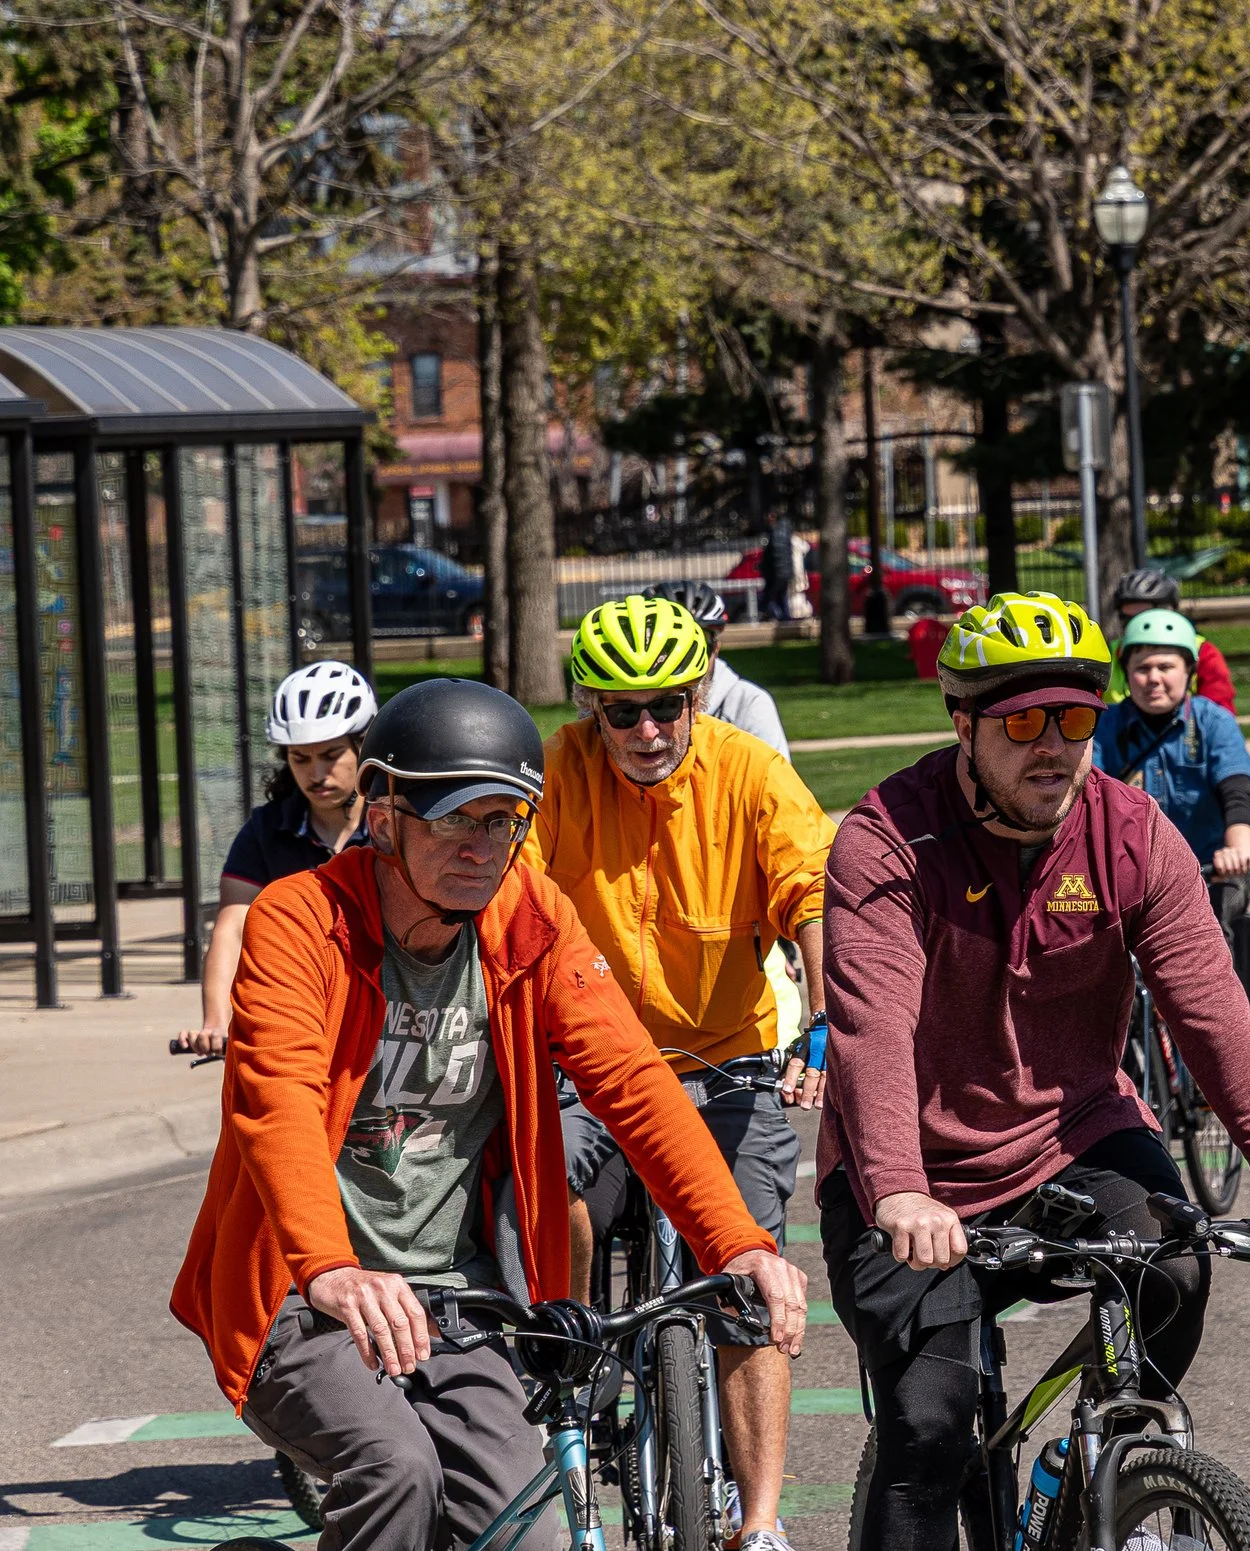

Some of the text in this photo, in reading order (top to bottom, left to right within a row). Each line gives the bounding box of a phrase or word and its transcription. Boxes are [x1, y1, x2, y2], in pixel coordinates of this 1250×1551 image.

[1046, 900, 1100, 912] MINNESOTA
[1054, 874, 1093, 899] M
[385, 1000, 469, 1042] NESOTA
[370, 1038, 489, 1108] ILD
[1023, 1491, 1049, 1551] POWE
